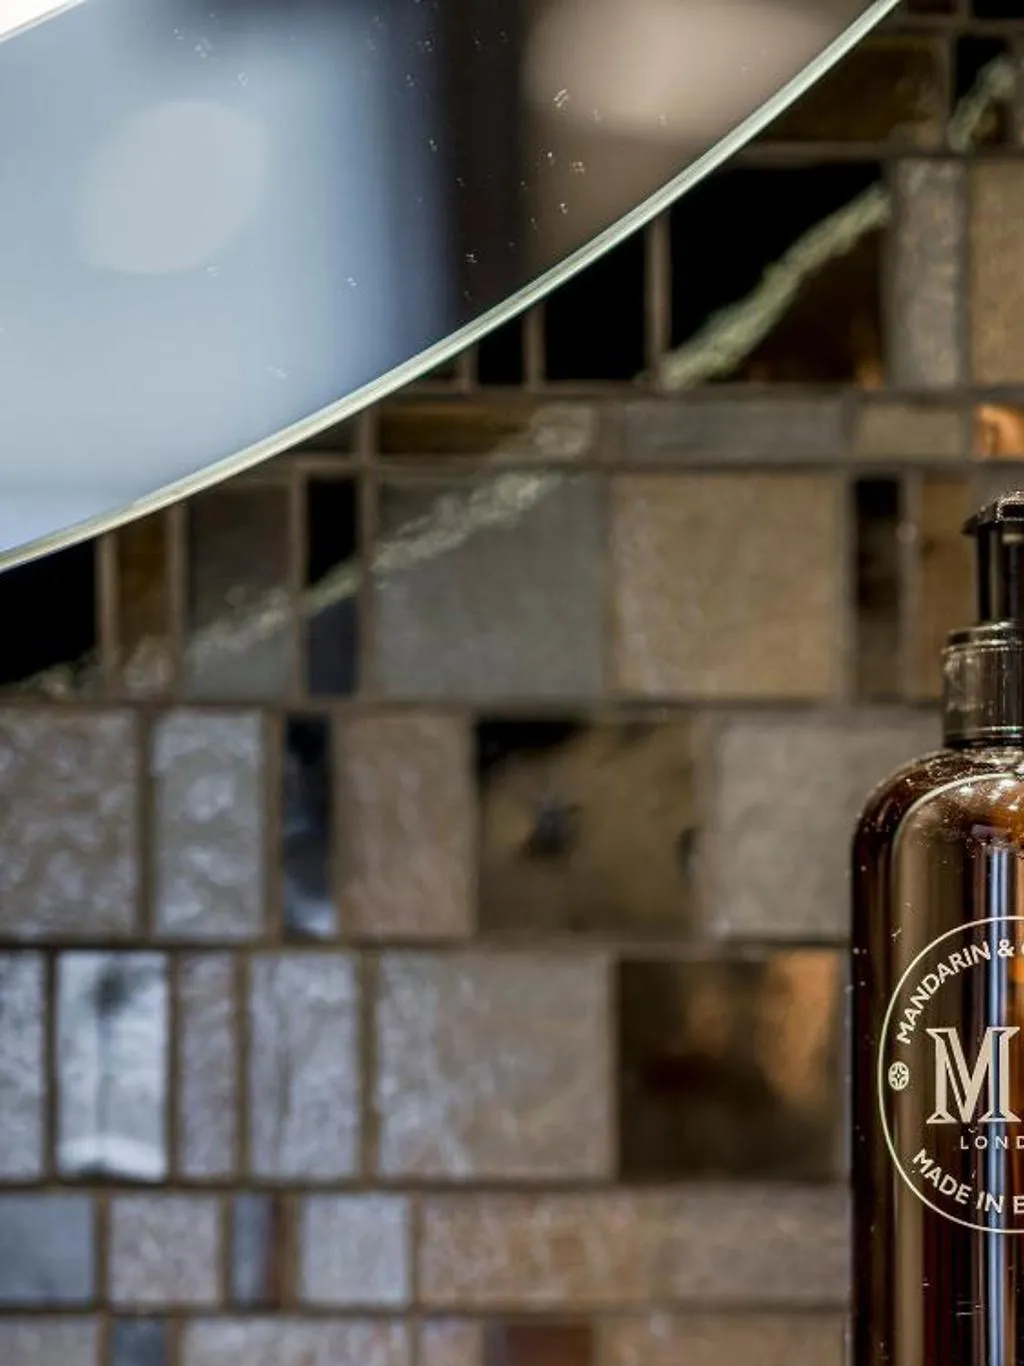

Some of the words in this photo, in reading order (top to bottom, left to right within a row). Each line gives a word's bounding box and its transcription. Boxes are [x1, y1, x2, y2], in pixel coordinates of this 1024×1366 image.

[896, 941, 991, 1044] MANDARIN
[997, 939, 1015, 958] &
[911, 1148, 977, 1205] MADE
[976, 1191, 1004, 1214] IN
